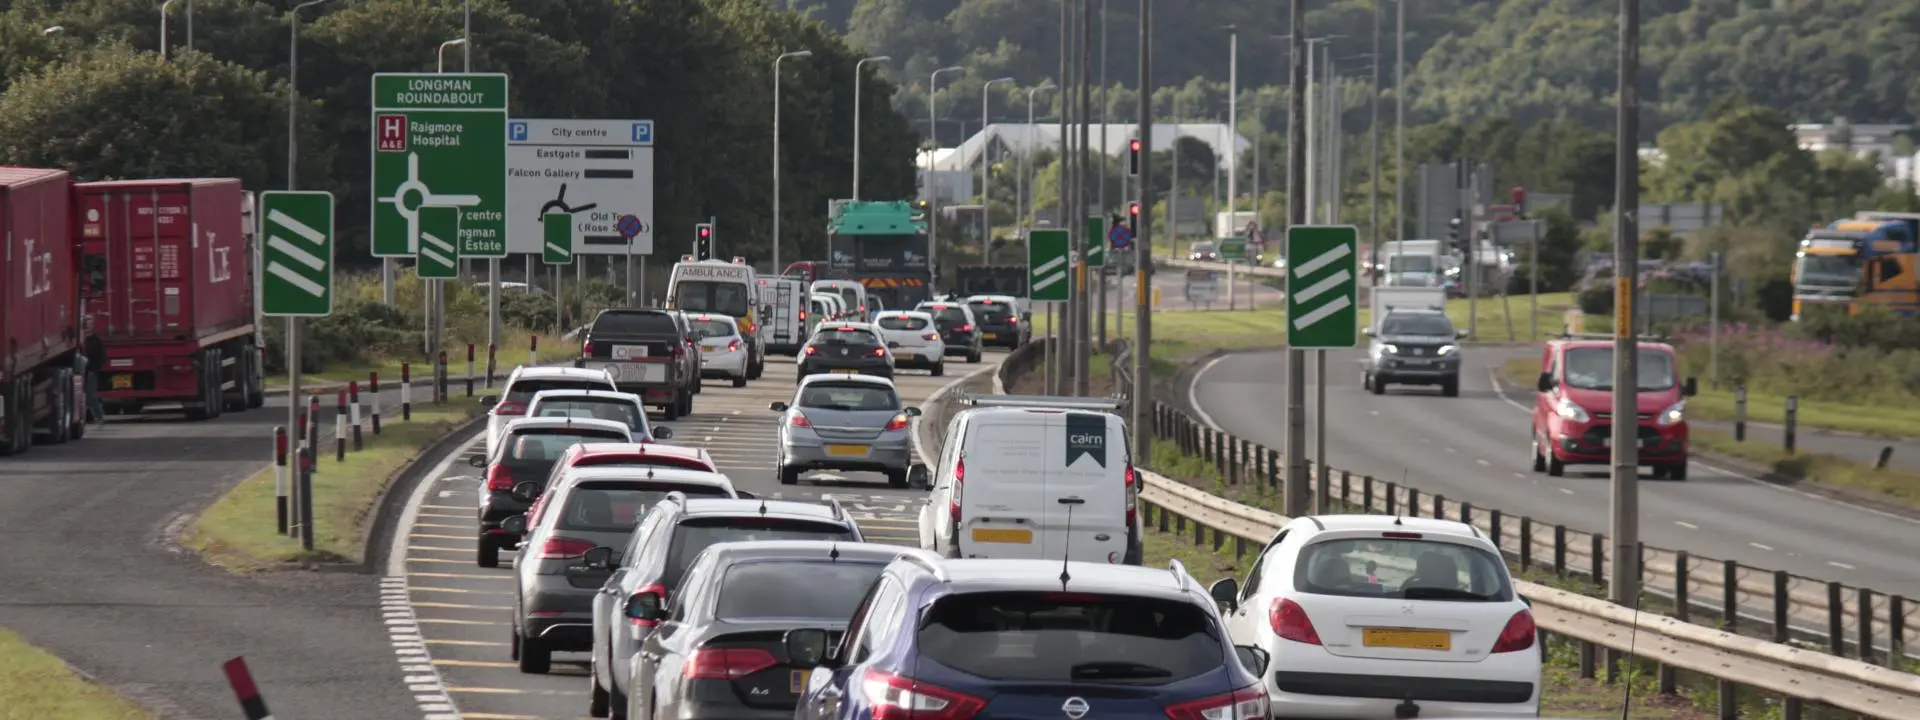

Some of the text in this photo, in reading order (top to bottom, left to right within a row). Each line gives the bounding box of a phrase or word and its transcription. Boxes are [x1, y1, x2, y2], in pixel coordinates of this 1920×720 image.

[409, 80, 471, 90] LONGMAN
[397, 93, 484, 104] ROUNDABOUT
[385, 119, 400, 138] H
[410, 121, 463, 134] Raigmore
[513, 124, 525, 139] P
[551, 127, 607, 138] City centre
[636, 125, 648, 140] P
[413, 135, 460, 147] Hospital
[537, 149, 580, 159] Eastgate
[508, 168, 580, 179] Falcon Gallery
[467, 209, 502, 221] centre
[591, 212, 608, 221] Old
[459, 229, 496, 239] ngman
[465, 240, 502, 251] Estate
[682, 267, 743, 278] AMBULANCE
[1070, 433, 1103, 445] cairn
[750, 687, 769, 696] A4
